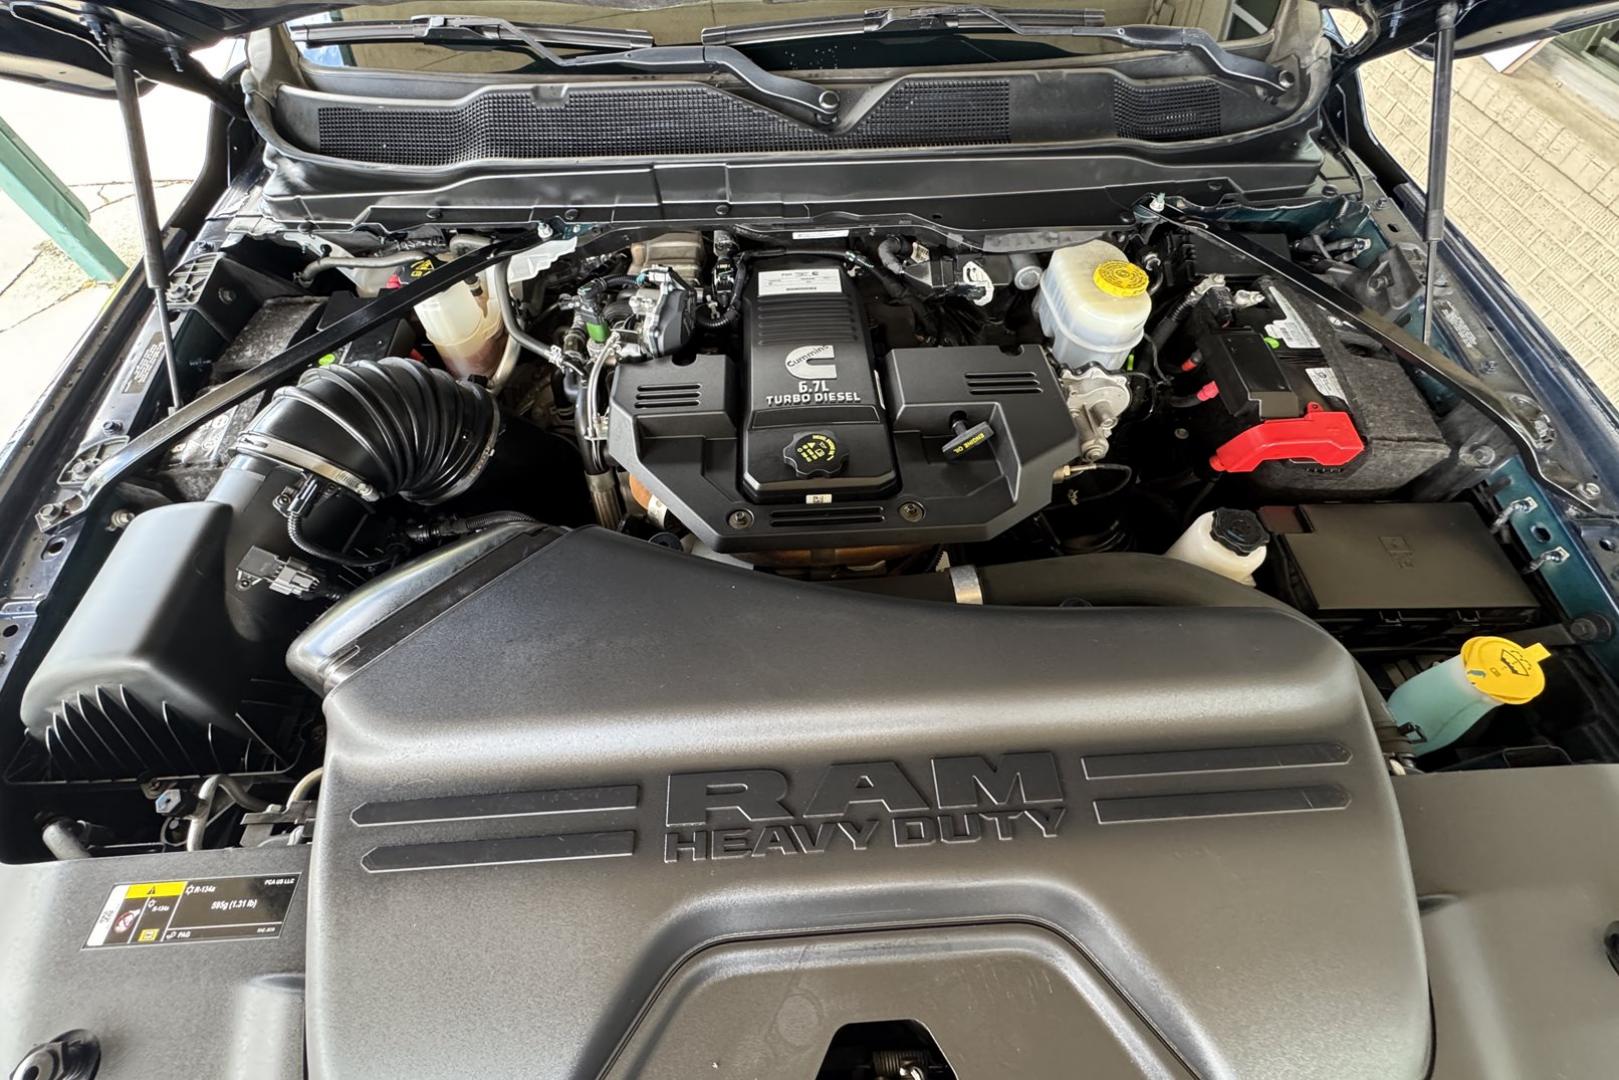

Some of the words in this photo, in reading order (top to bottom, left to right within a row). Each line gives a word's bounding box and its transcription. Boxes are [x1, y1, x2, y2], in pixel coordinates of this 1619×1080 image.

[798, 380, 829, 393] 6.7L
[766, 393, 811, 405] TURBO
[814, 391, 861, 403] DIESEL
[963, 432, 985, 449] ENGINE
[666, 750, 1064, 827] RAM
[664, 820, 880, 863] HEAVY
[892, 808, 1066, 848] DUTY
[193, 885, 216, 893] R-134a
[229, 899, 246, 910] (1.31
[246, 899, 258, 909] lb)
